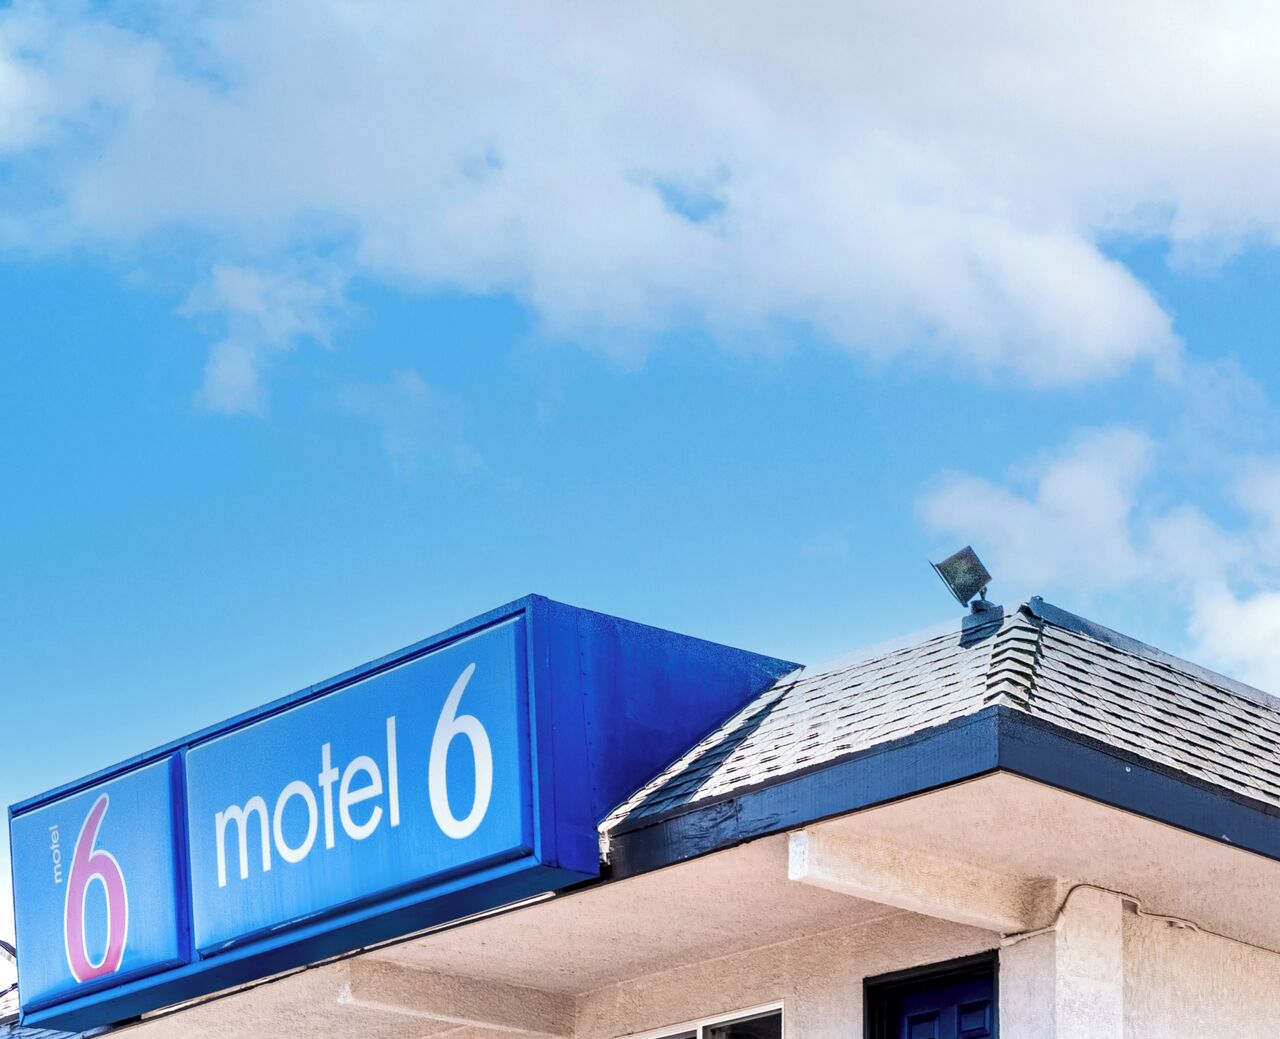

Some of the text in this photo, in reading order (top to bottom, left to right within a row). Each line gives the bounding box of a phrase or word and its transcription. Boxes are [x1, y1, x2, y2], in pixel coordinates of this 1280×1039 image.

[48, 824, 63, 885] motel
[215, 662, 493, 888] motel 6
[64, 792, 129, 984] 6
